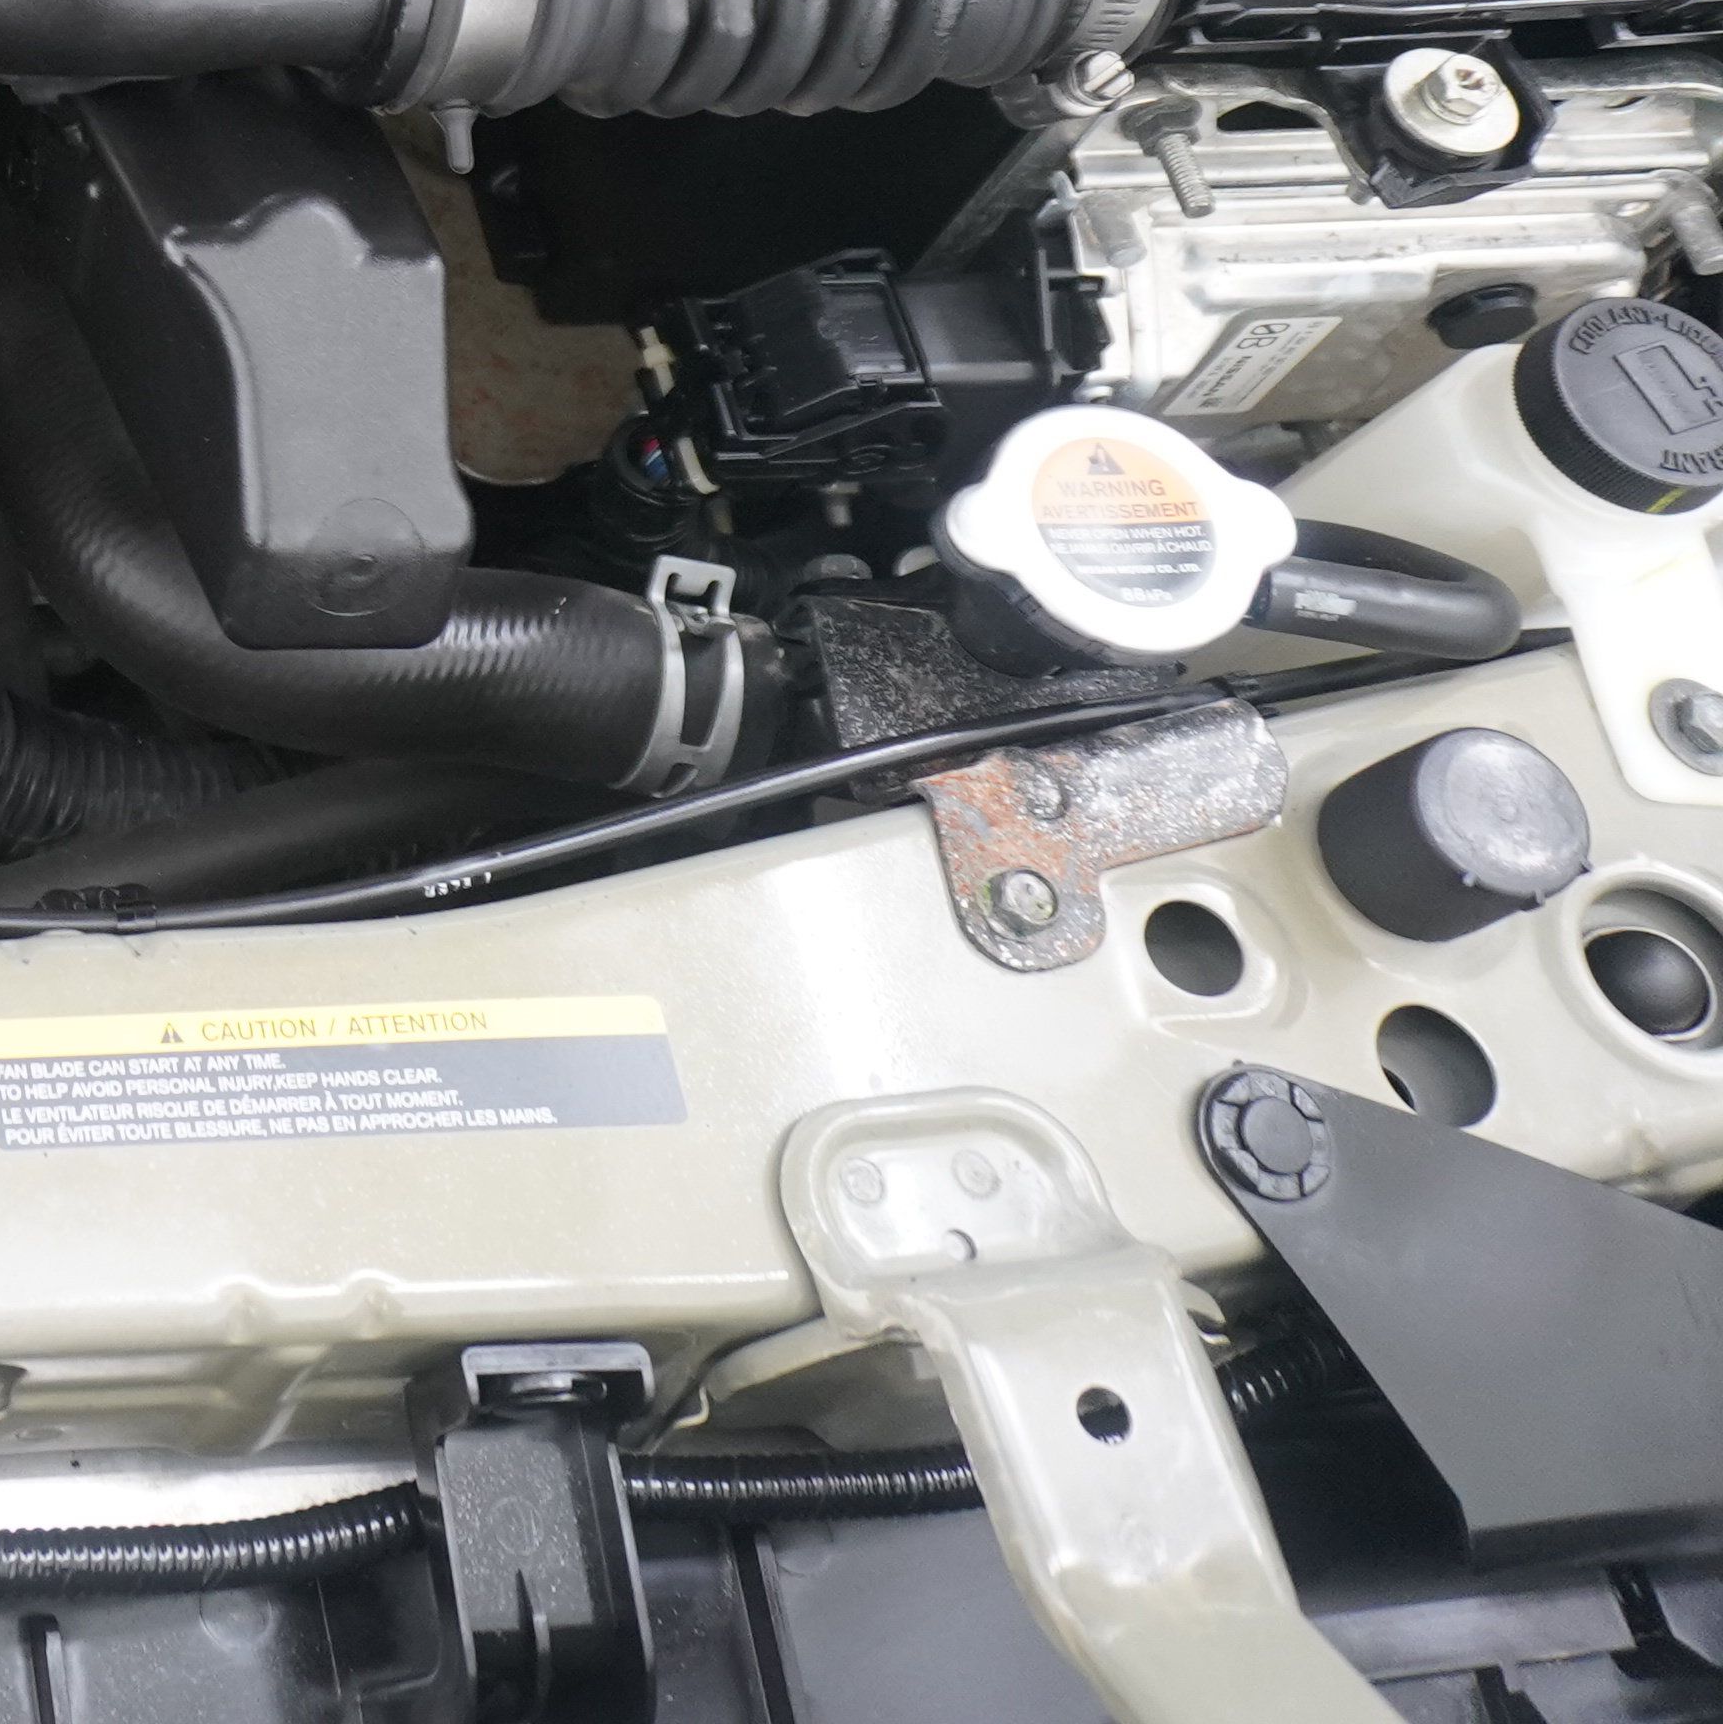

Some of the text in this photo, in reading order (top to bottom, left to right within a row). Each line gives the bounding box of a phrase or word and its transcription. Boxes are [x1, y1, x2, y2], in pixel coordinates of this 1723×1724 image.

[1057, 478, 1167, 498] WARNING
[1041, 501, 1199, 520] AVERTISSEMENT
[1093, 526, 1130, 540] OPEN
[1130, 526, 1173, 540] WHEN
[1175, 525, 1207, 539] HOT.
[1111, 541, 1155, 554] OUVRIR
[202, 1019, 318, 1042] CAUTION
[349, 1012, 488, 1036] ATTENTION
[30, 1061, 86, 1080] BLADE
[88, 1059, 126, 1078] CAN
[128, 1057, 179, 1076] START
[183, 1056, 203, 1073] AT
[206, 1054, 240, 1072] ANY
[242, 1052, 287, 1071] TIME.
[25, 1082, 69, 1100] HELP
[71, 1080, 123, 1098] AVOID
[126, 1077, 216, 1097] PERSONAL
[322, 1070, 381, 1088] HANDS
[383, 1067, 443, 1086] CLEAR.
[2, 1089, 464, 1125] LE VENTILATEUR RISQUE DE DÉMARRER À TOUT MOMENT.
[5, 1106, 558, 1146] POUR ÉVITER TOUTE BLESSURE, NE PAS EN APPROCHER LES MAINS.
